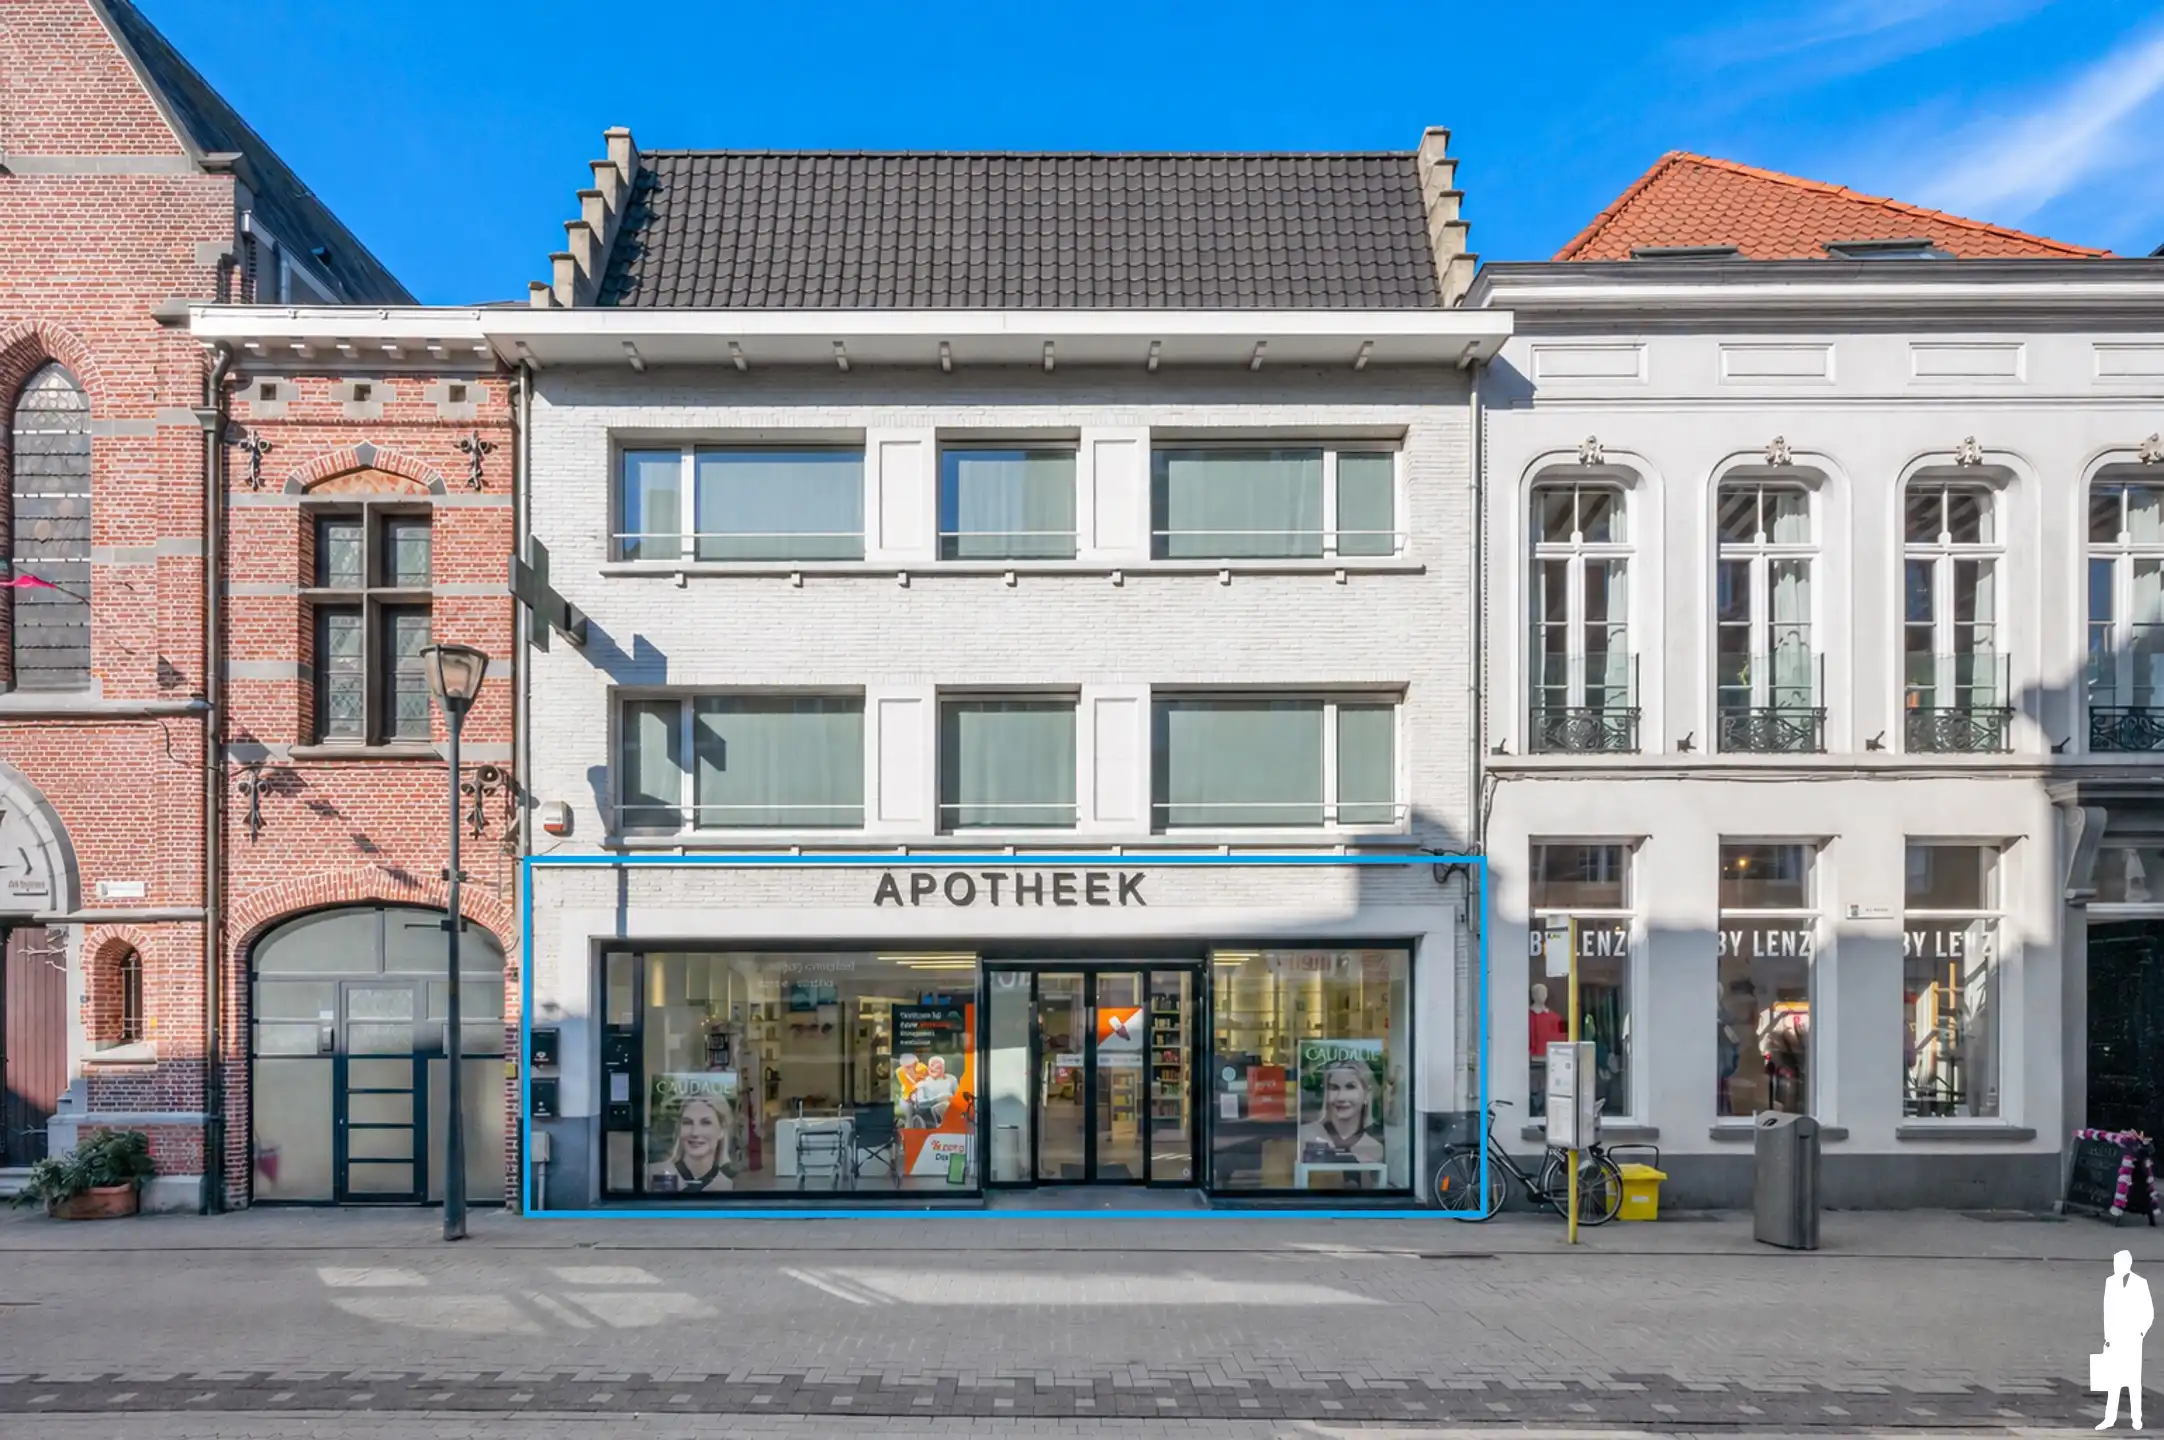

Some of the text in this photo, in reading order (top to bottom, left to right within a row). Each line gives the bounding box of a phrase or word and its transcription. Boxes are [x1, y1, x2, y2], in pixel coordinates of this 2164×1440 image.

[873, 871, 1147, 907] APOTHEEK
[1576, 929, 1626, 957] ENZ
[1717, 930, 1811, 957] BY LENZ
